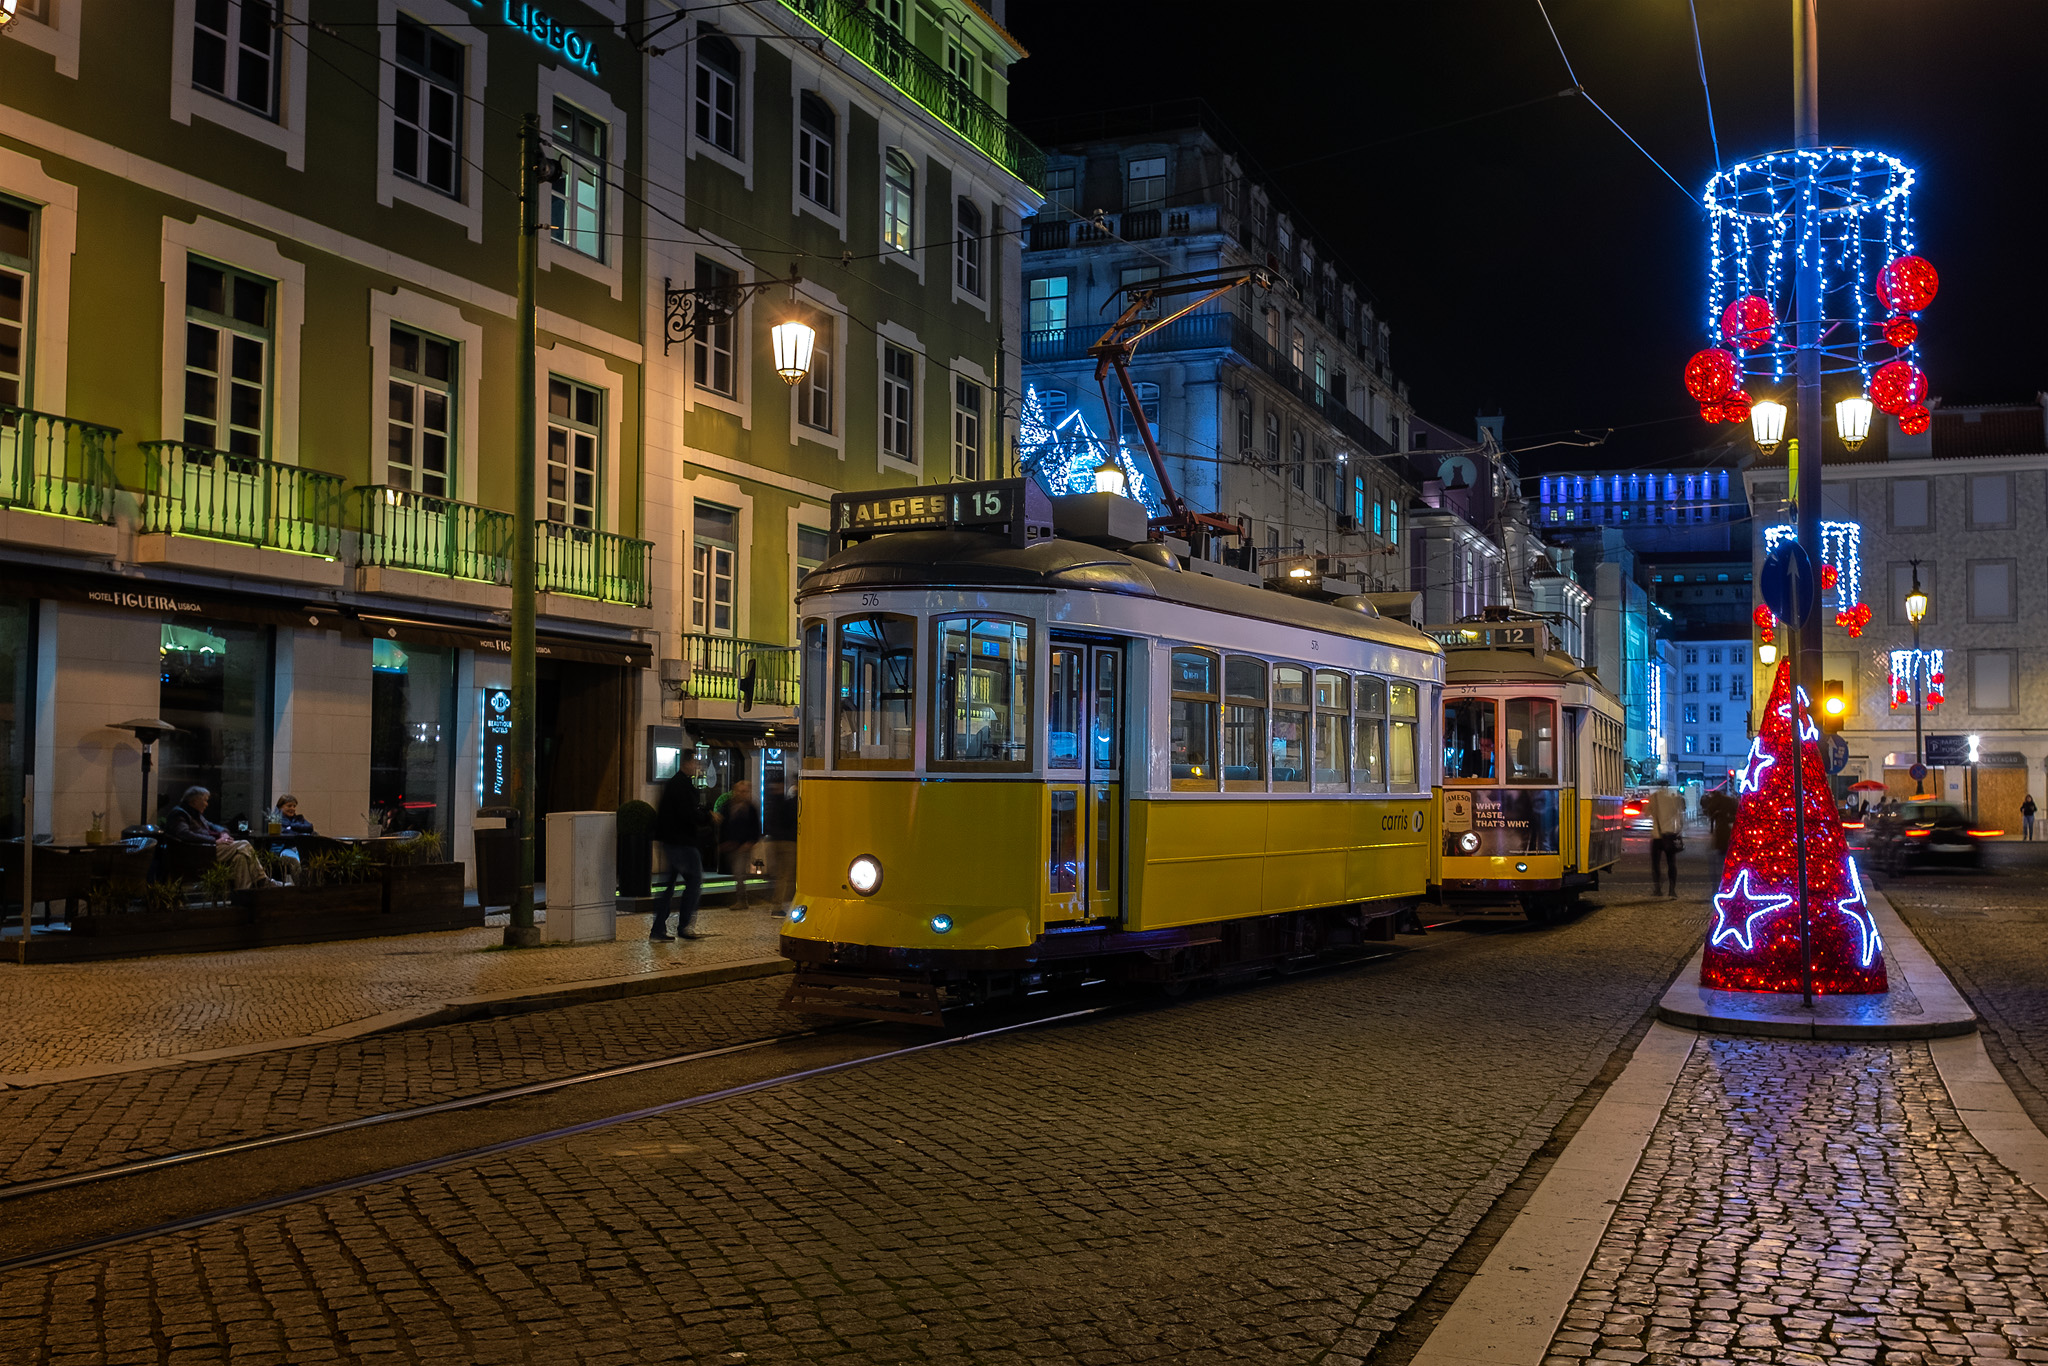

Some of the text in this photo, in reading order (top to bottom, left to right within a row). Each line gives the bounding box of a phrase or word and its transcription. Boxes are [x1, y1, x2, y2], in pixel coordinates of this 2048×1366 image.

[504, 0, 601, 76] LISBOA
[855, 496, 946, 521] ALGES
[972, 490, 1001, 516] 15
[88, 591, 202, 612] HOTEL FIGUEIRA LISBOA
[862, 593, 879, 606] 576
[1311, 640, 1319, 650] 576
[1504, 629, 1524, 643] 12
[494, 744, 504, 795] Figueira
[1381, 808, 1408, 831] carris
[1476, 811, 1505, 819] TASTE,
[1476, 820, 1505, 828] THAT'S
